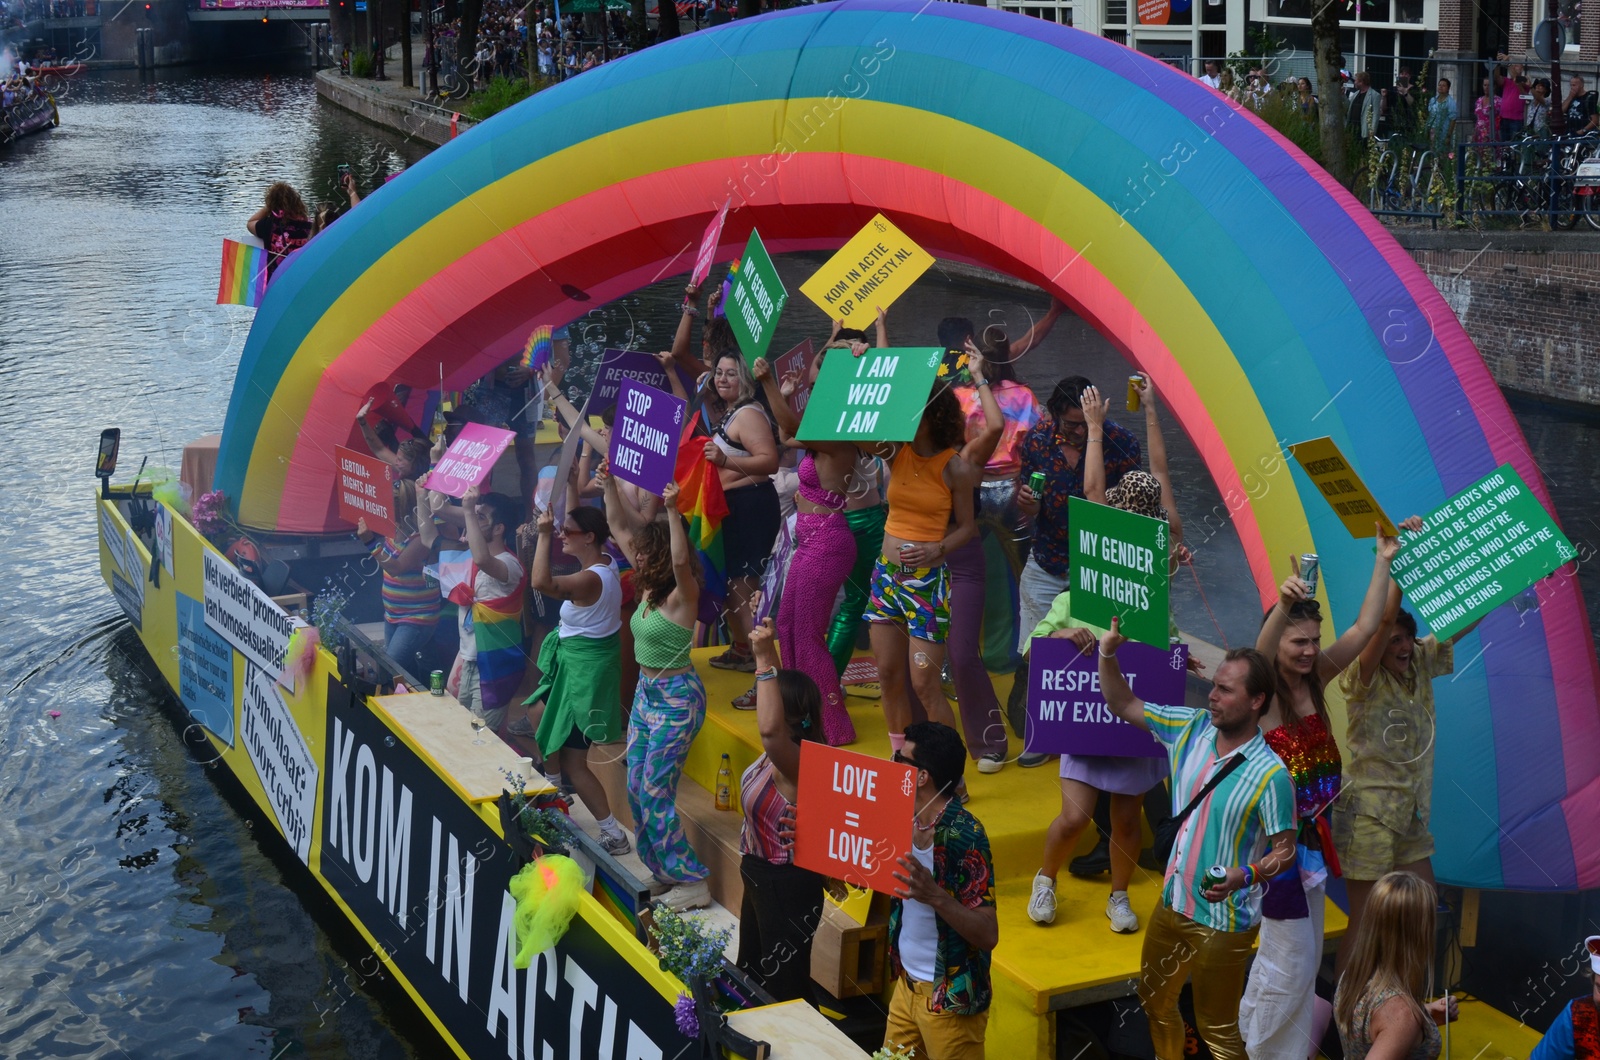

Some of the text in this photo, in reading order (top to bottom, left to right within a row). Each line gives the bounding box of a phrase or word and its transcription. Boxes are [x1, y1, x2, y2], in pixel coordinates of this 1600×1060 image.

[743, 256, 774, 323] MY GENDER
[824, 242, 889, 304] KOM IN ACTIE
[839, 248, 913, 316] OP AMNESTY.NL
[734, 281, 763, 344] MY RIGHTS
[788, 352, 806, 373] LOVE
[856, 356, 899, 377] I AM
[600, 385, 619, 399] MY
[626, 389, 652, 417] STOP
[847, 384, 892, 405] WHO
[621, 416, 669, 456] TEACHING
[836, 411, 880, 433] I AM
[341, 458, 371, 479] LGBTQIA+
[437, 458, 482, 482] MY RIGHTS
[451, 439, 491, 461] MY BODY
[615, 444, 644, 475] HATE!
[343, 476, 377, 499] RIGHTS ARE
[344, 492, 388, 519] HUMAN RIGHTS
[1406, 474, 1505, 541] WHO LOVE BOYS WHO
[1389, 552, 1414, 574] LOVE
[1412, 535, 1440, 558] BOYS
[1438, 527, 1454, 541] TO
[1452, 517, 1469, 533] BE
[1467, 499, 1498, 523] GIRLS
[1494, 485, 1520, 505] WHO
[1397, 510, 1513, 589] LOVE BOYS LIKE THEY'RE
[1079, 529, 1154, 575] MY GENDER
[1409, 520, 1530, 603] HUMAN BEINGS WHO LOVE
[1419, 526, 1553, 618] HUMAN BEINGS LIKE THEY'RE
[204, 555, 218, 588] Wet
[219, 572, 250, 611] verbiedt
[1080, 565, 1149, 611] MY RIGHTS
[205, 596, 218, 621] van
[1429, 580, 1503, 632] HUMAN BEINGS
[1041, 669, 1137, 694] RESPET
[1039, 700, 1067, 722] MY
[832, 762, 878, 802] LOVE
[329, 716, 413, 931] KOM
[426, 815, 475, 1004] IN
[828, 828, 873, 870] LOVE
